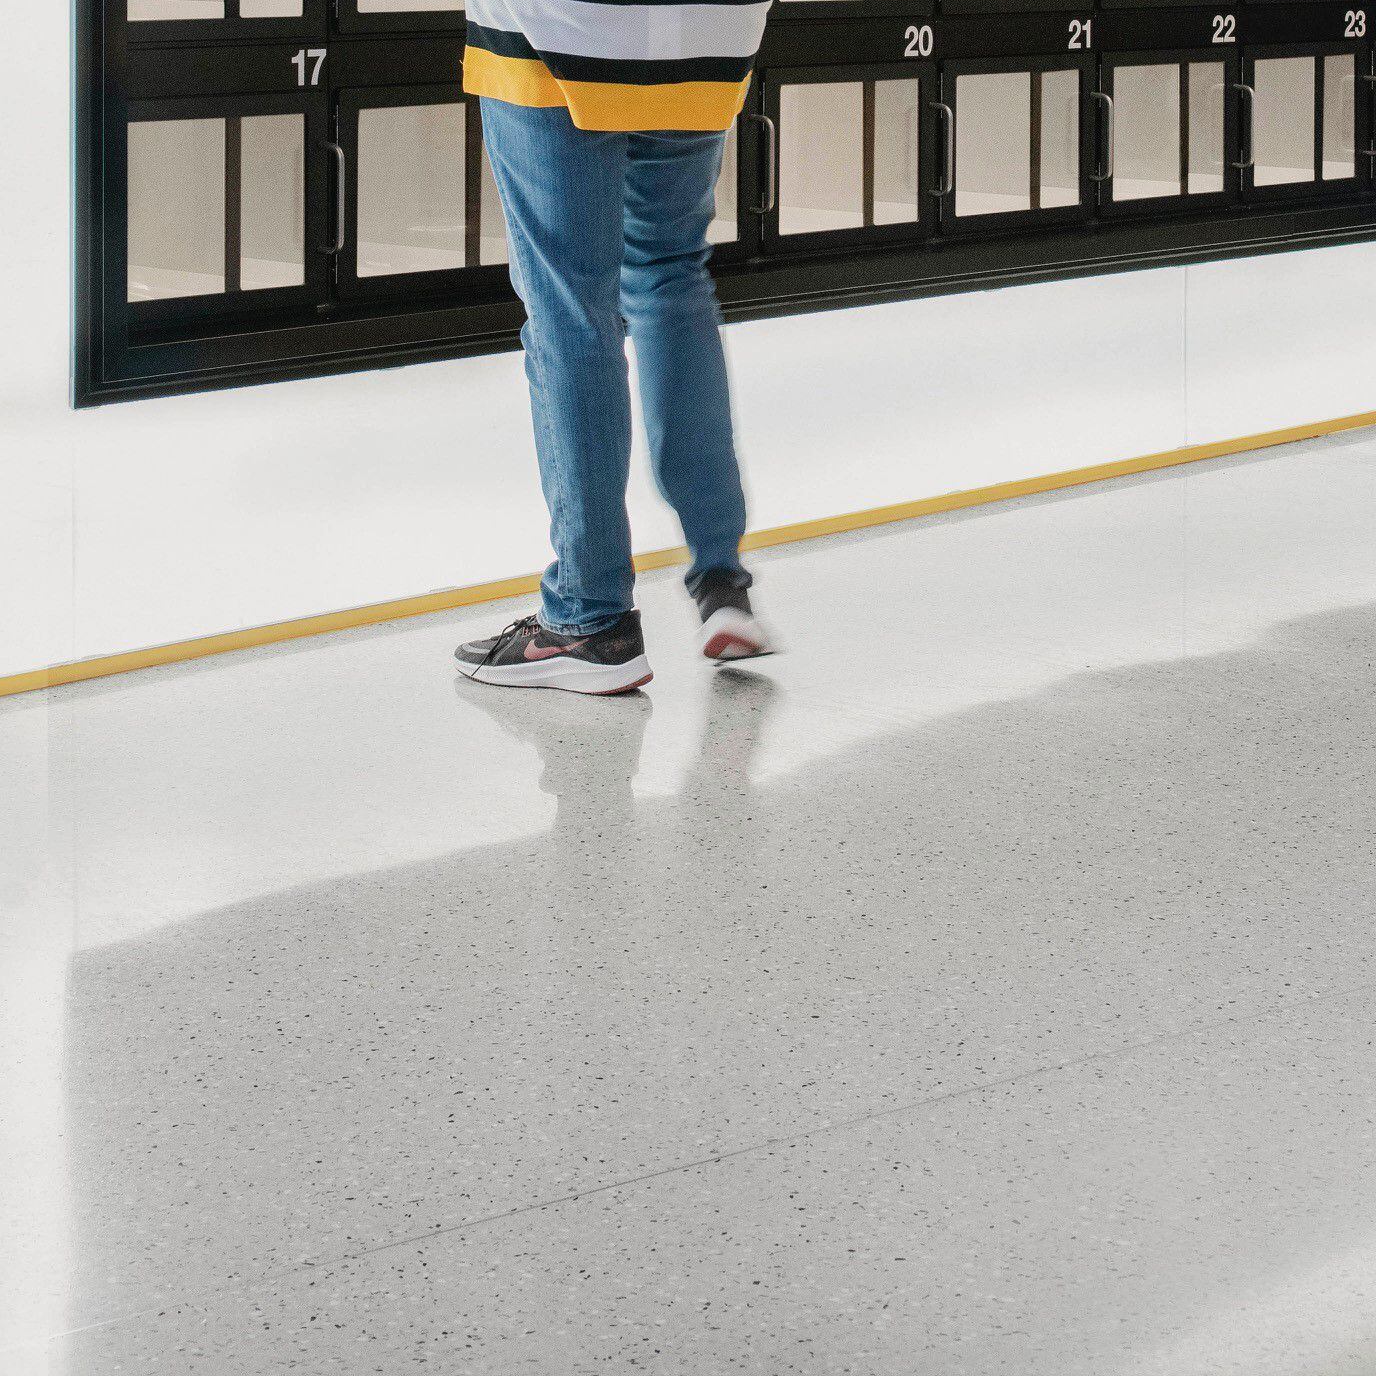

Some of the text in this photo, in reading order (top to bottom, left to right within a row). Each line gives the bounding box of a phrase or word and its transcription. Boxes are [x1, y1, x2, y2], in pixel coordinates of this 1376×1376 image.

[1069, 19, 1091, 49] 21
[1212, 15, 1235, 43] 22
[1345, 10, 1366, 38] 23
[904, 26, 934, 57] 20
[291, 49, 326, 85] 17
